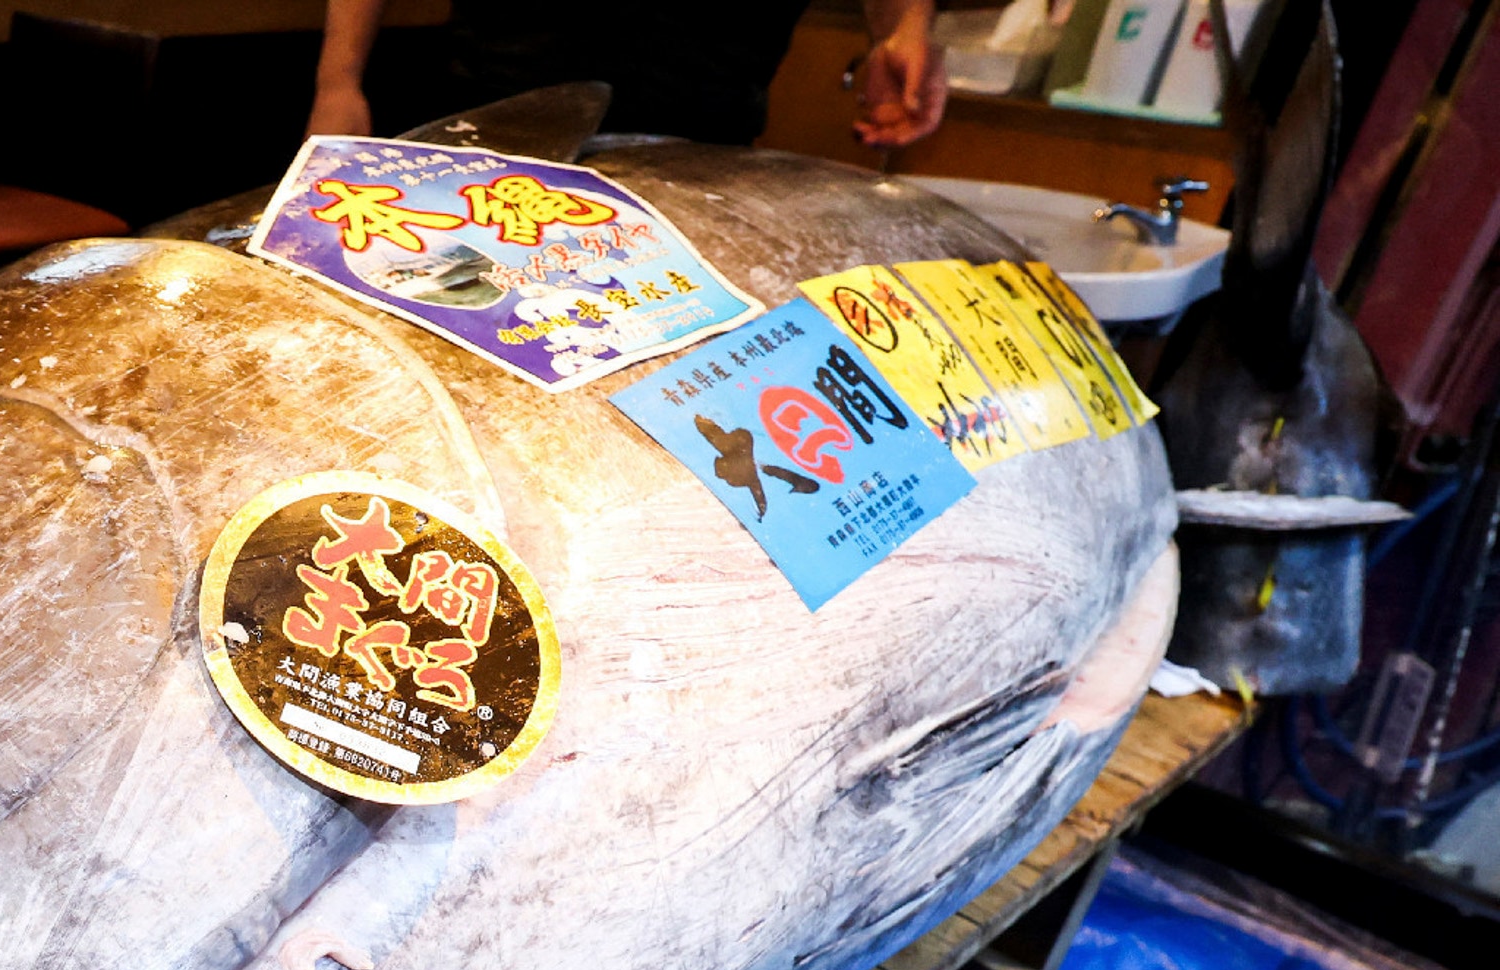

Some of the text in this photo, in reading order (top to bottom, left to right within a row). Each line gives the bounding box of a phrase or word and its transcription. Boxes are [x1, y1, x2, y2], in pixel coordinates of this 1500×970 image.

[275, 655, 451, 736] 大間漁業協同組合
